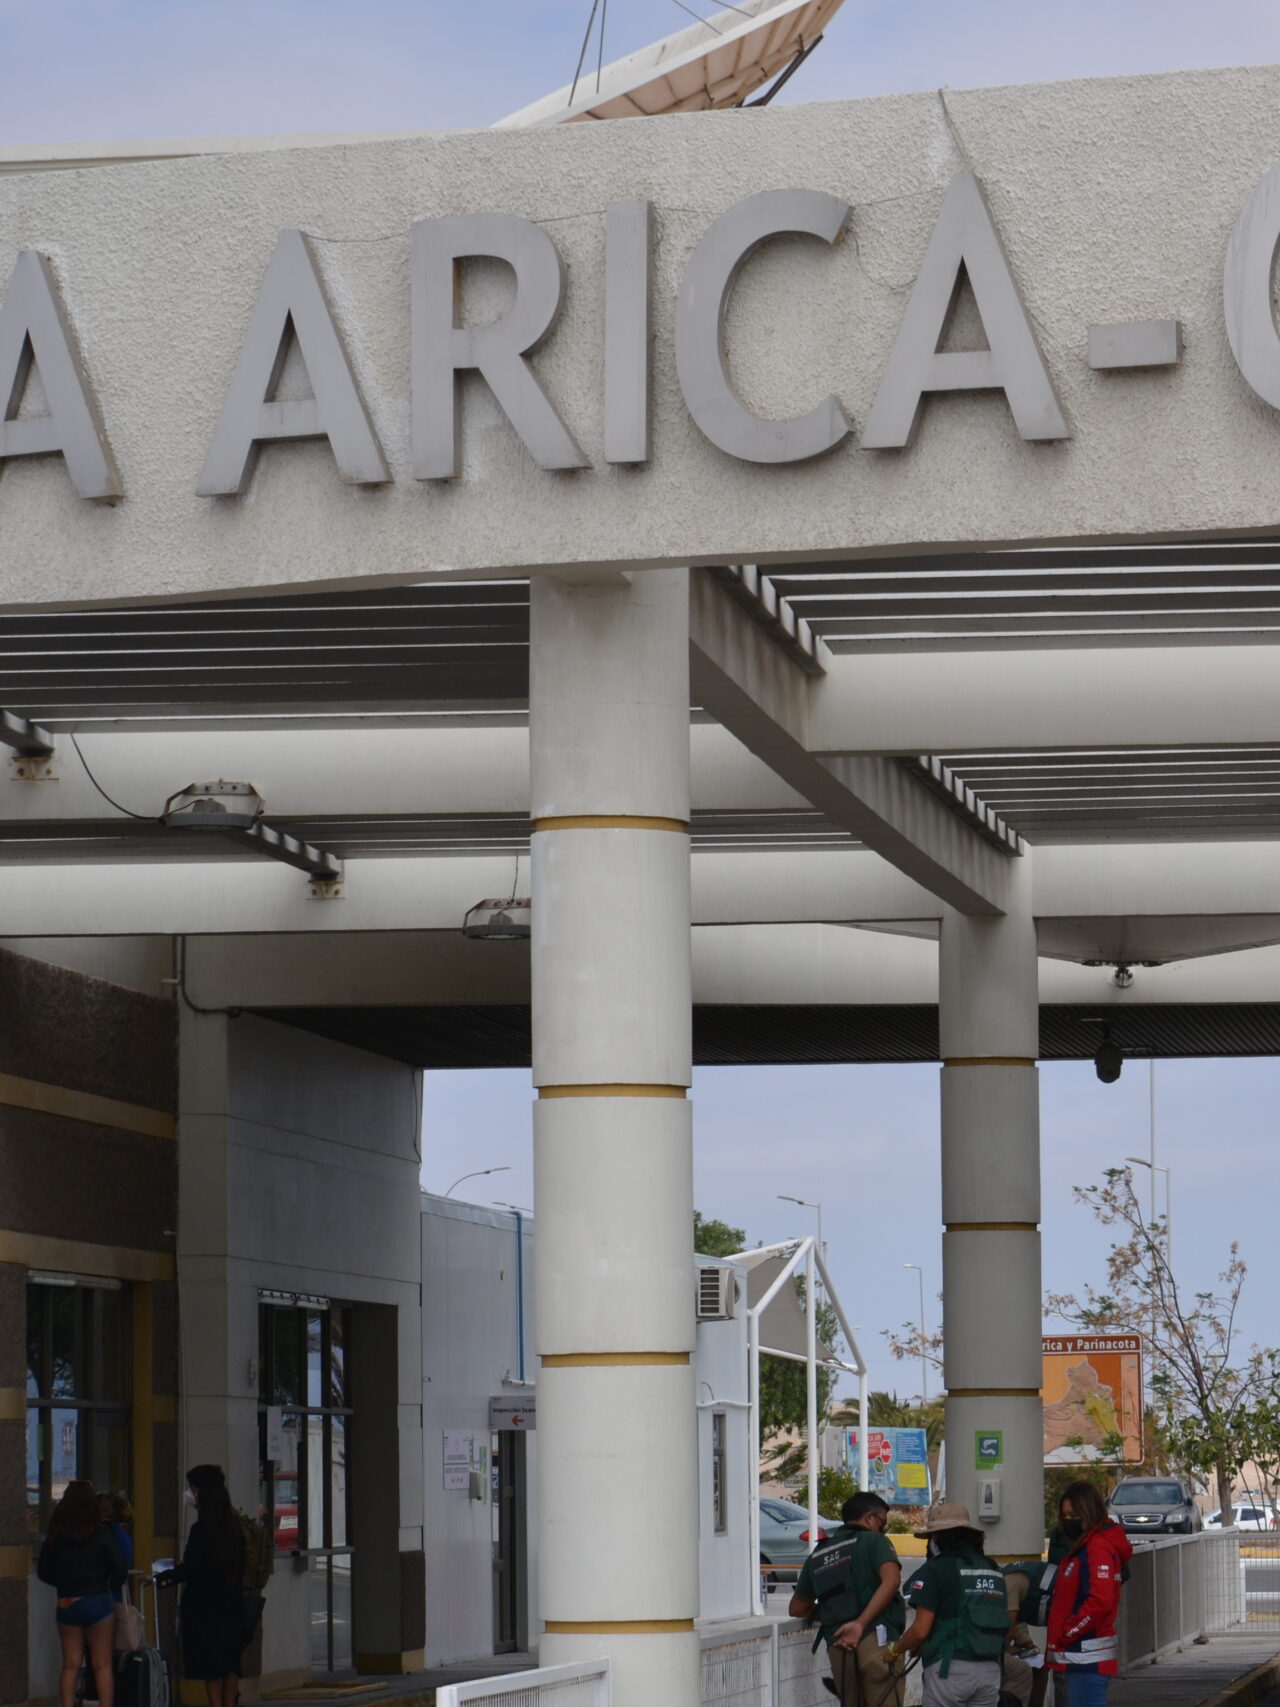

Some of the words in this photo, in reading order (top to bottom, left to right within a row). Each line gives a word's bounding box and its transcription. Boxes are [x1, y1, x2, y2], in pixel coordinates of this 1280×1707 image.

[0, 249, 123, 505] A
[195, 170, 1073, 497] ARICA
[1042, 1339, 1063, 1351] rica
[1067, 1342, 1073, 1352] y
[1077, 1339, 1136, 1350] Parinacota
[823, 1550, 840, 1565] SAG
[975, 1579, 995, 1589] SAG
